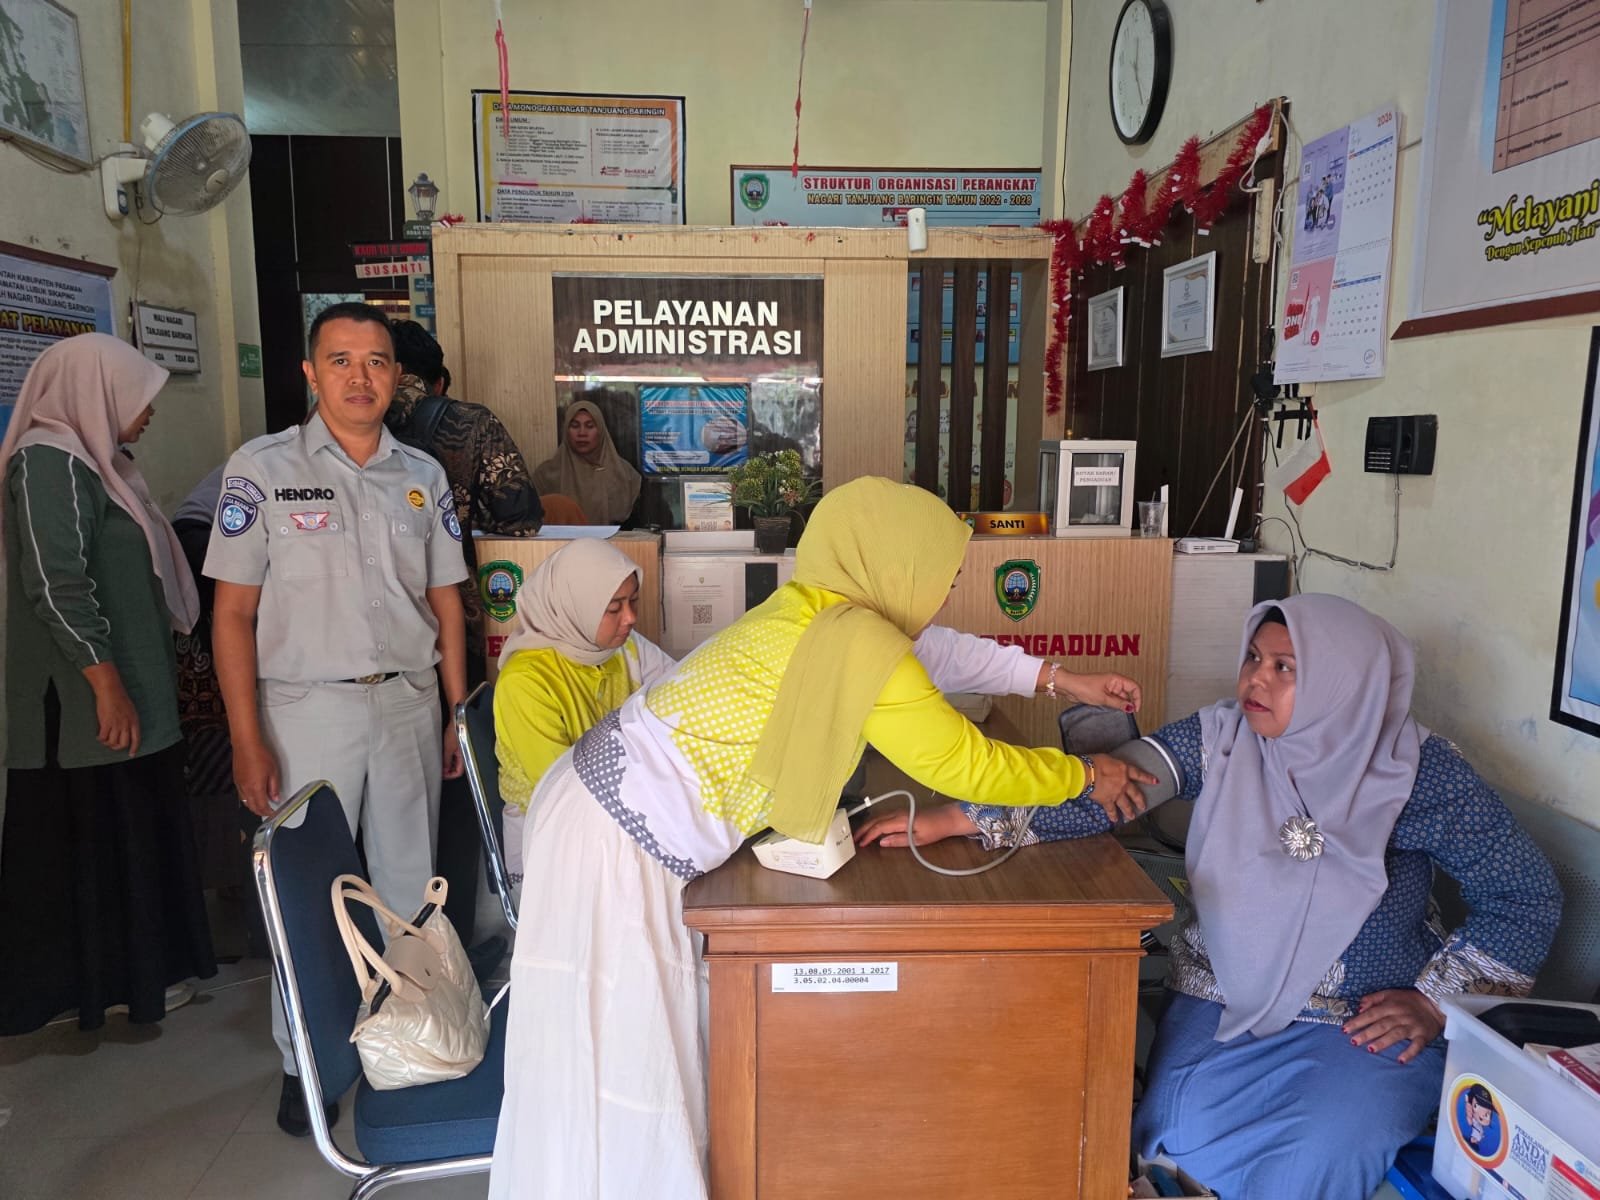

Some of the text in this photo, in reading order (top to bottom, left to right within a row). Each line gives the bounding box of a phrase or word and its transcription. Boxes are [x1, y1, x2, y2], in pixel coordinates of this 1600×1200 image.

[629, 108, 666, 116] BARINGIN
[803, 177, 1036, 192] STRUKTUR ORGANISASI PERANGKAT
[807, 193, 843, 205] NAGARI
[846, 193, 895, 206] TANJUANG
[898, 194, 943, 206] BARINGIN
[946, 194, 977, 206] TAHUN
[979, 194, 1001, 206] 2022
[1485, 242, 1521, 261] Dengan
[1521, 228, 1568, 255] Sepenuh
[364, 262, 423, 276] SUSANTI
[17, 274, 54, 288] KABUPATEN
[593, 299, 778, 326] PELAYANAN
[21, 312, 96, 338] PELAYANAN
[573, 328, 802, 355] ADMINISTRASI
[274, 488, 335, 502] HENDRO
[990, 519, 1025, 529] SANTI
[980, 634, 1140, 657] ENGADUAN
